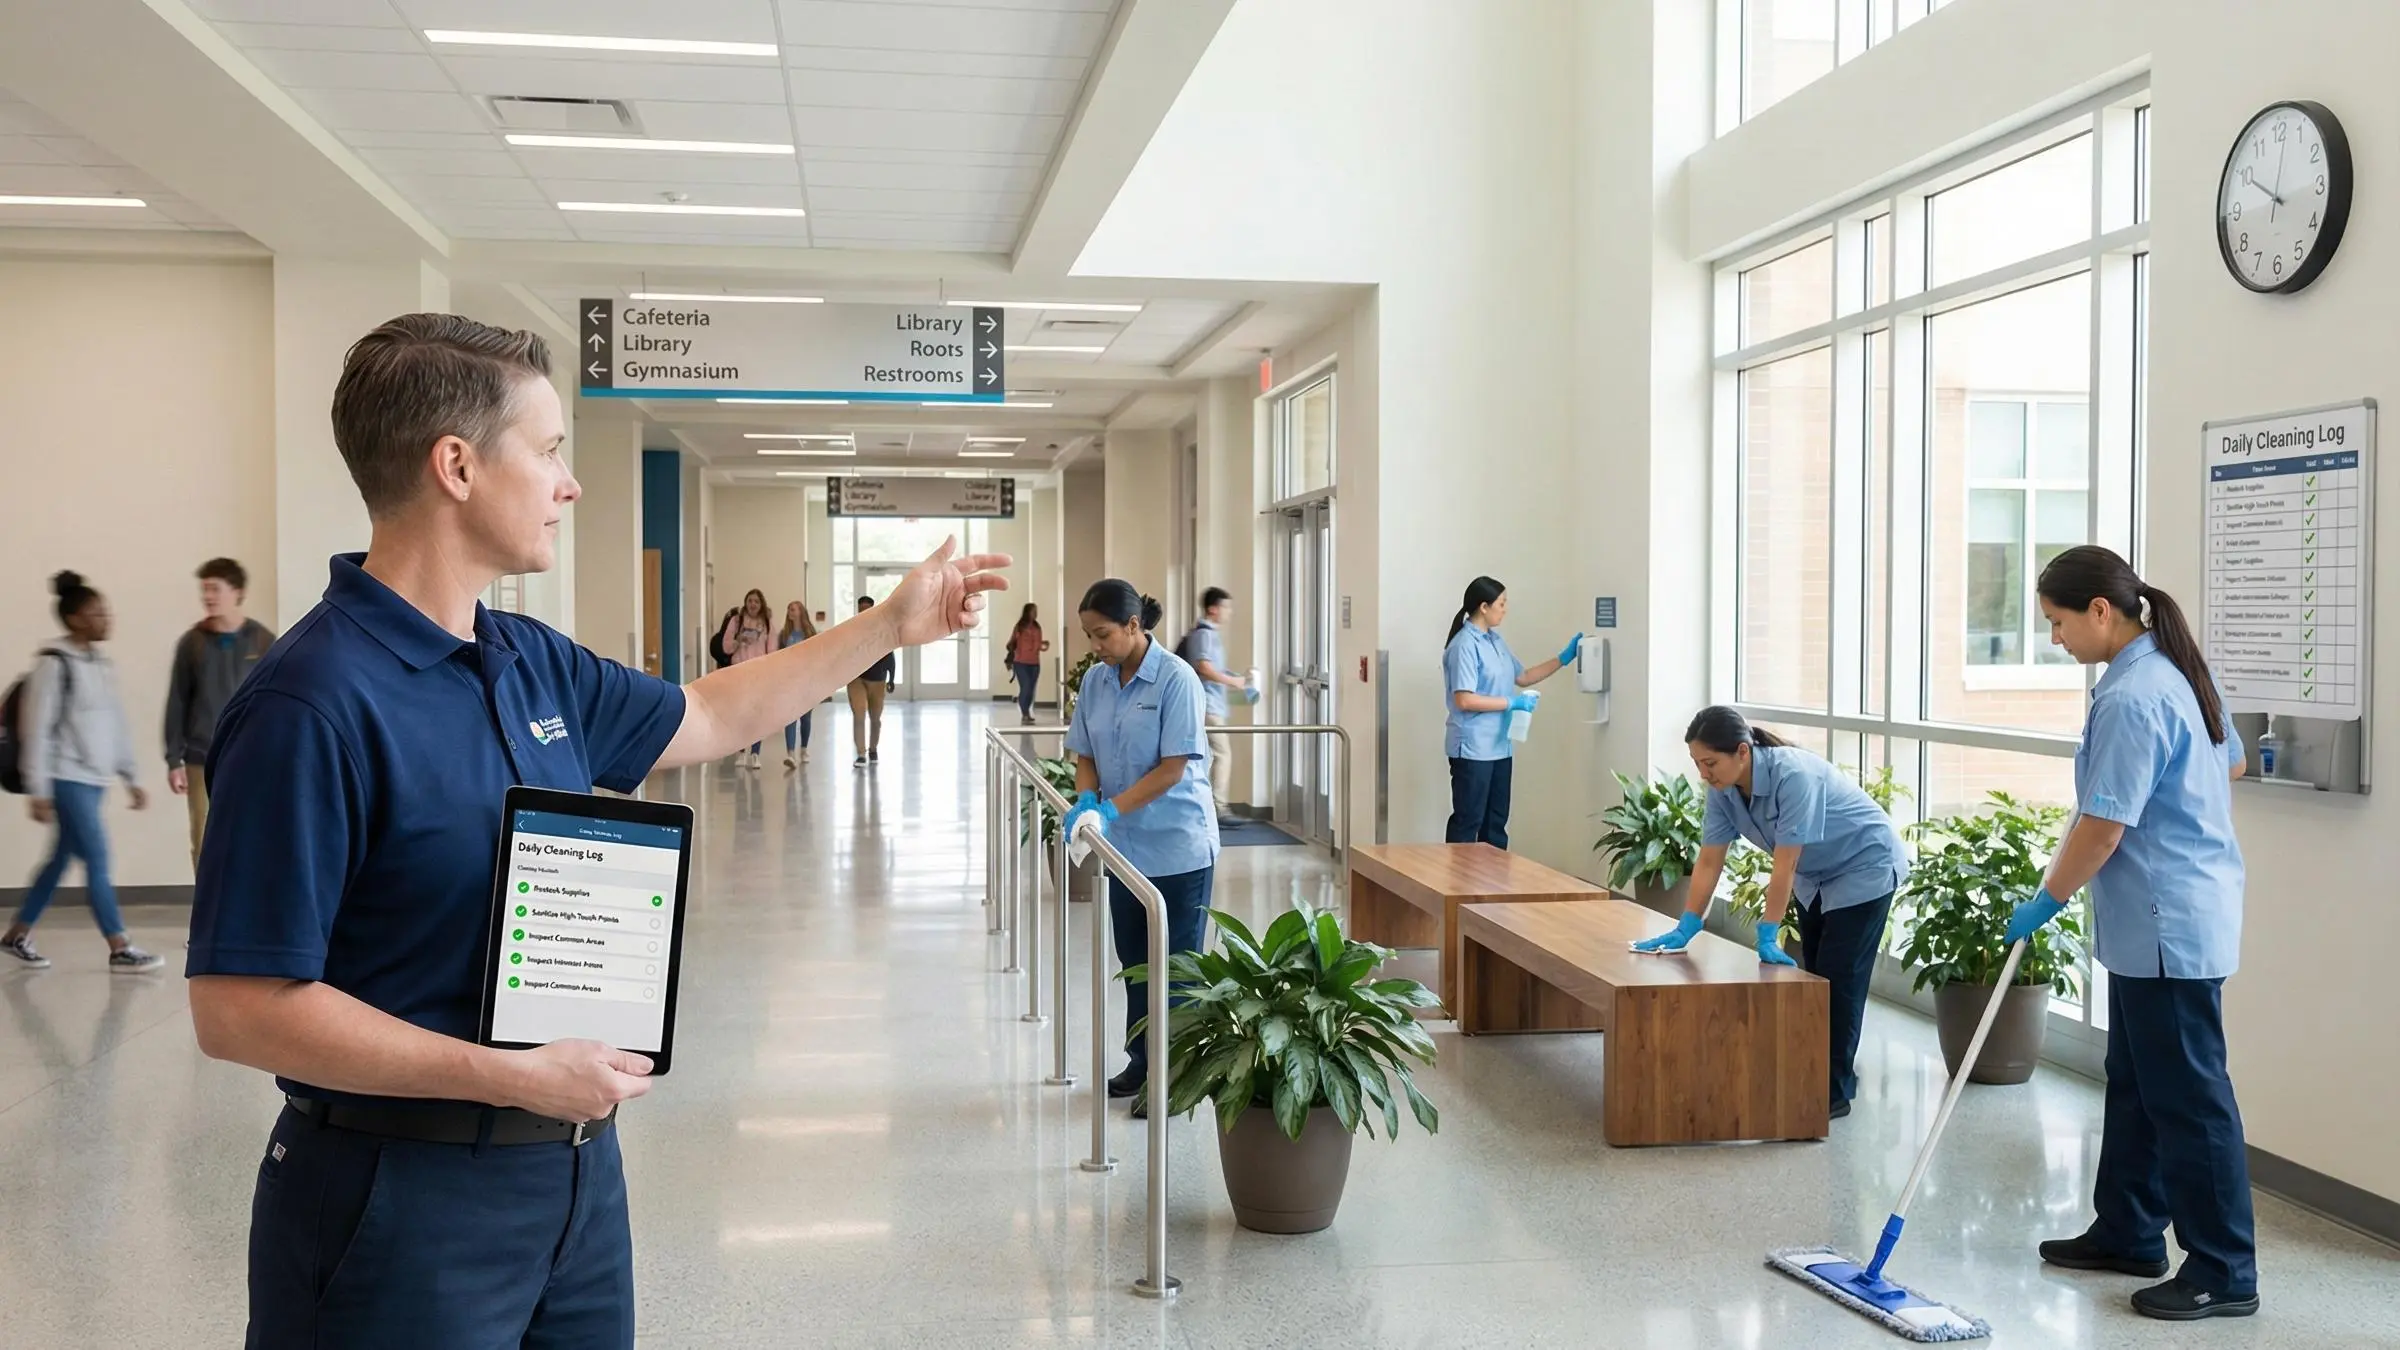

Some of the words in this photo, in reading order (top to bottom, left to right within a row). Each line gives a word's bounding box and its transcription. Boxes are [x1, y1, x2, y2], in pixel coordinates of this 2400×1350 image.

[2271, 122, 2287, 143] 12
[2296, 124, 2302, 143] 1
[2254, 138, 2266, 159] 11
[2310, 143, 2320, 164] 2
[2240, 166, 2254, 187] 10
[2315, 174, 2325, 195] 3
[2232, 202, 2242, 222] 9
[2308, 211, 2318, 231] 4
[2240, 232, 2249, 252] 8
[2294, 240, 2304, 261] 5
[2254, 251, 2263, 272] 7
[2273, 255, 2282, 275] 6
[623, 307, 710, 326] Cafeteria
[896, 313, 963, 336] Library
[624, 334, 692, 356] Library
[911, 340, 964, 357] Roots
[623, 361, 739, 382] Gymnasium
[864, 365, 964, 383] Restrooms
[2222, 433, 2253, 456] Daily
[2256, 426, 2314, 450] Cleaning
[2318, 424, 2345, 445] Log
[518, 842, 542, 856] Daily
[544, 845, 585, 860] Cleaning
[586, 850, 604, 862] Log
